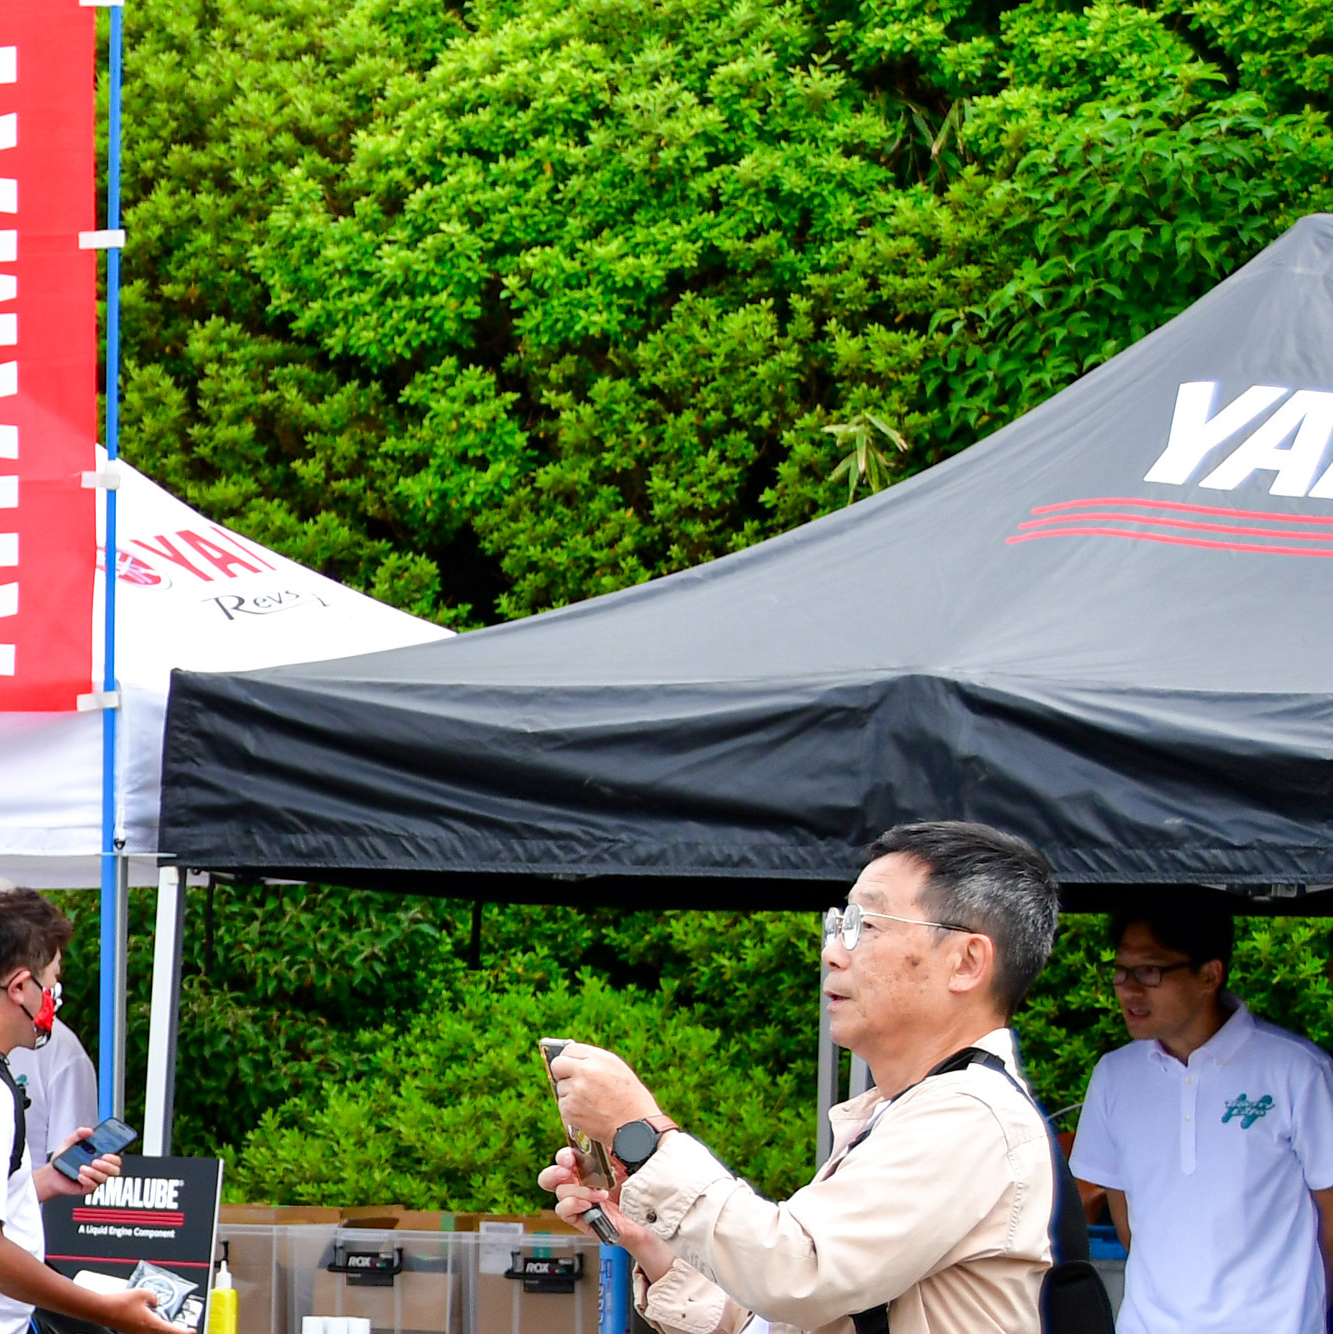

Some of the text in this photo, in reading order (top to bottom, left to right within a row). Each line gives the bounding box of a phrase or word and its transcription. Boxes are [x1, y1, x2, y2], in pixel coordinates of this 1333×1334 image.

[1143, 380, 1333, 498] YA
[202, 588, 301, 620] Revs
[78, 1225, 176, 1240] A Liquid Engine Component
[348, 1256, 371, 1267] ROX
[526, 1263, 549, 1274] ROX
